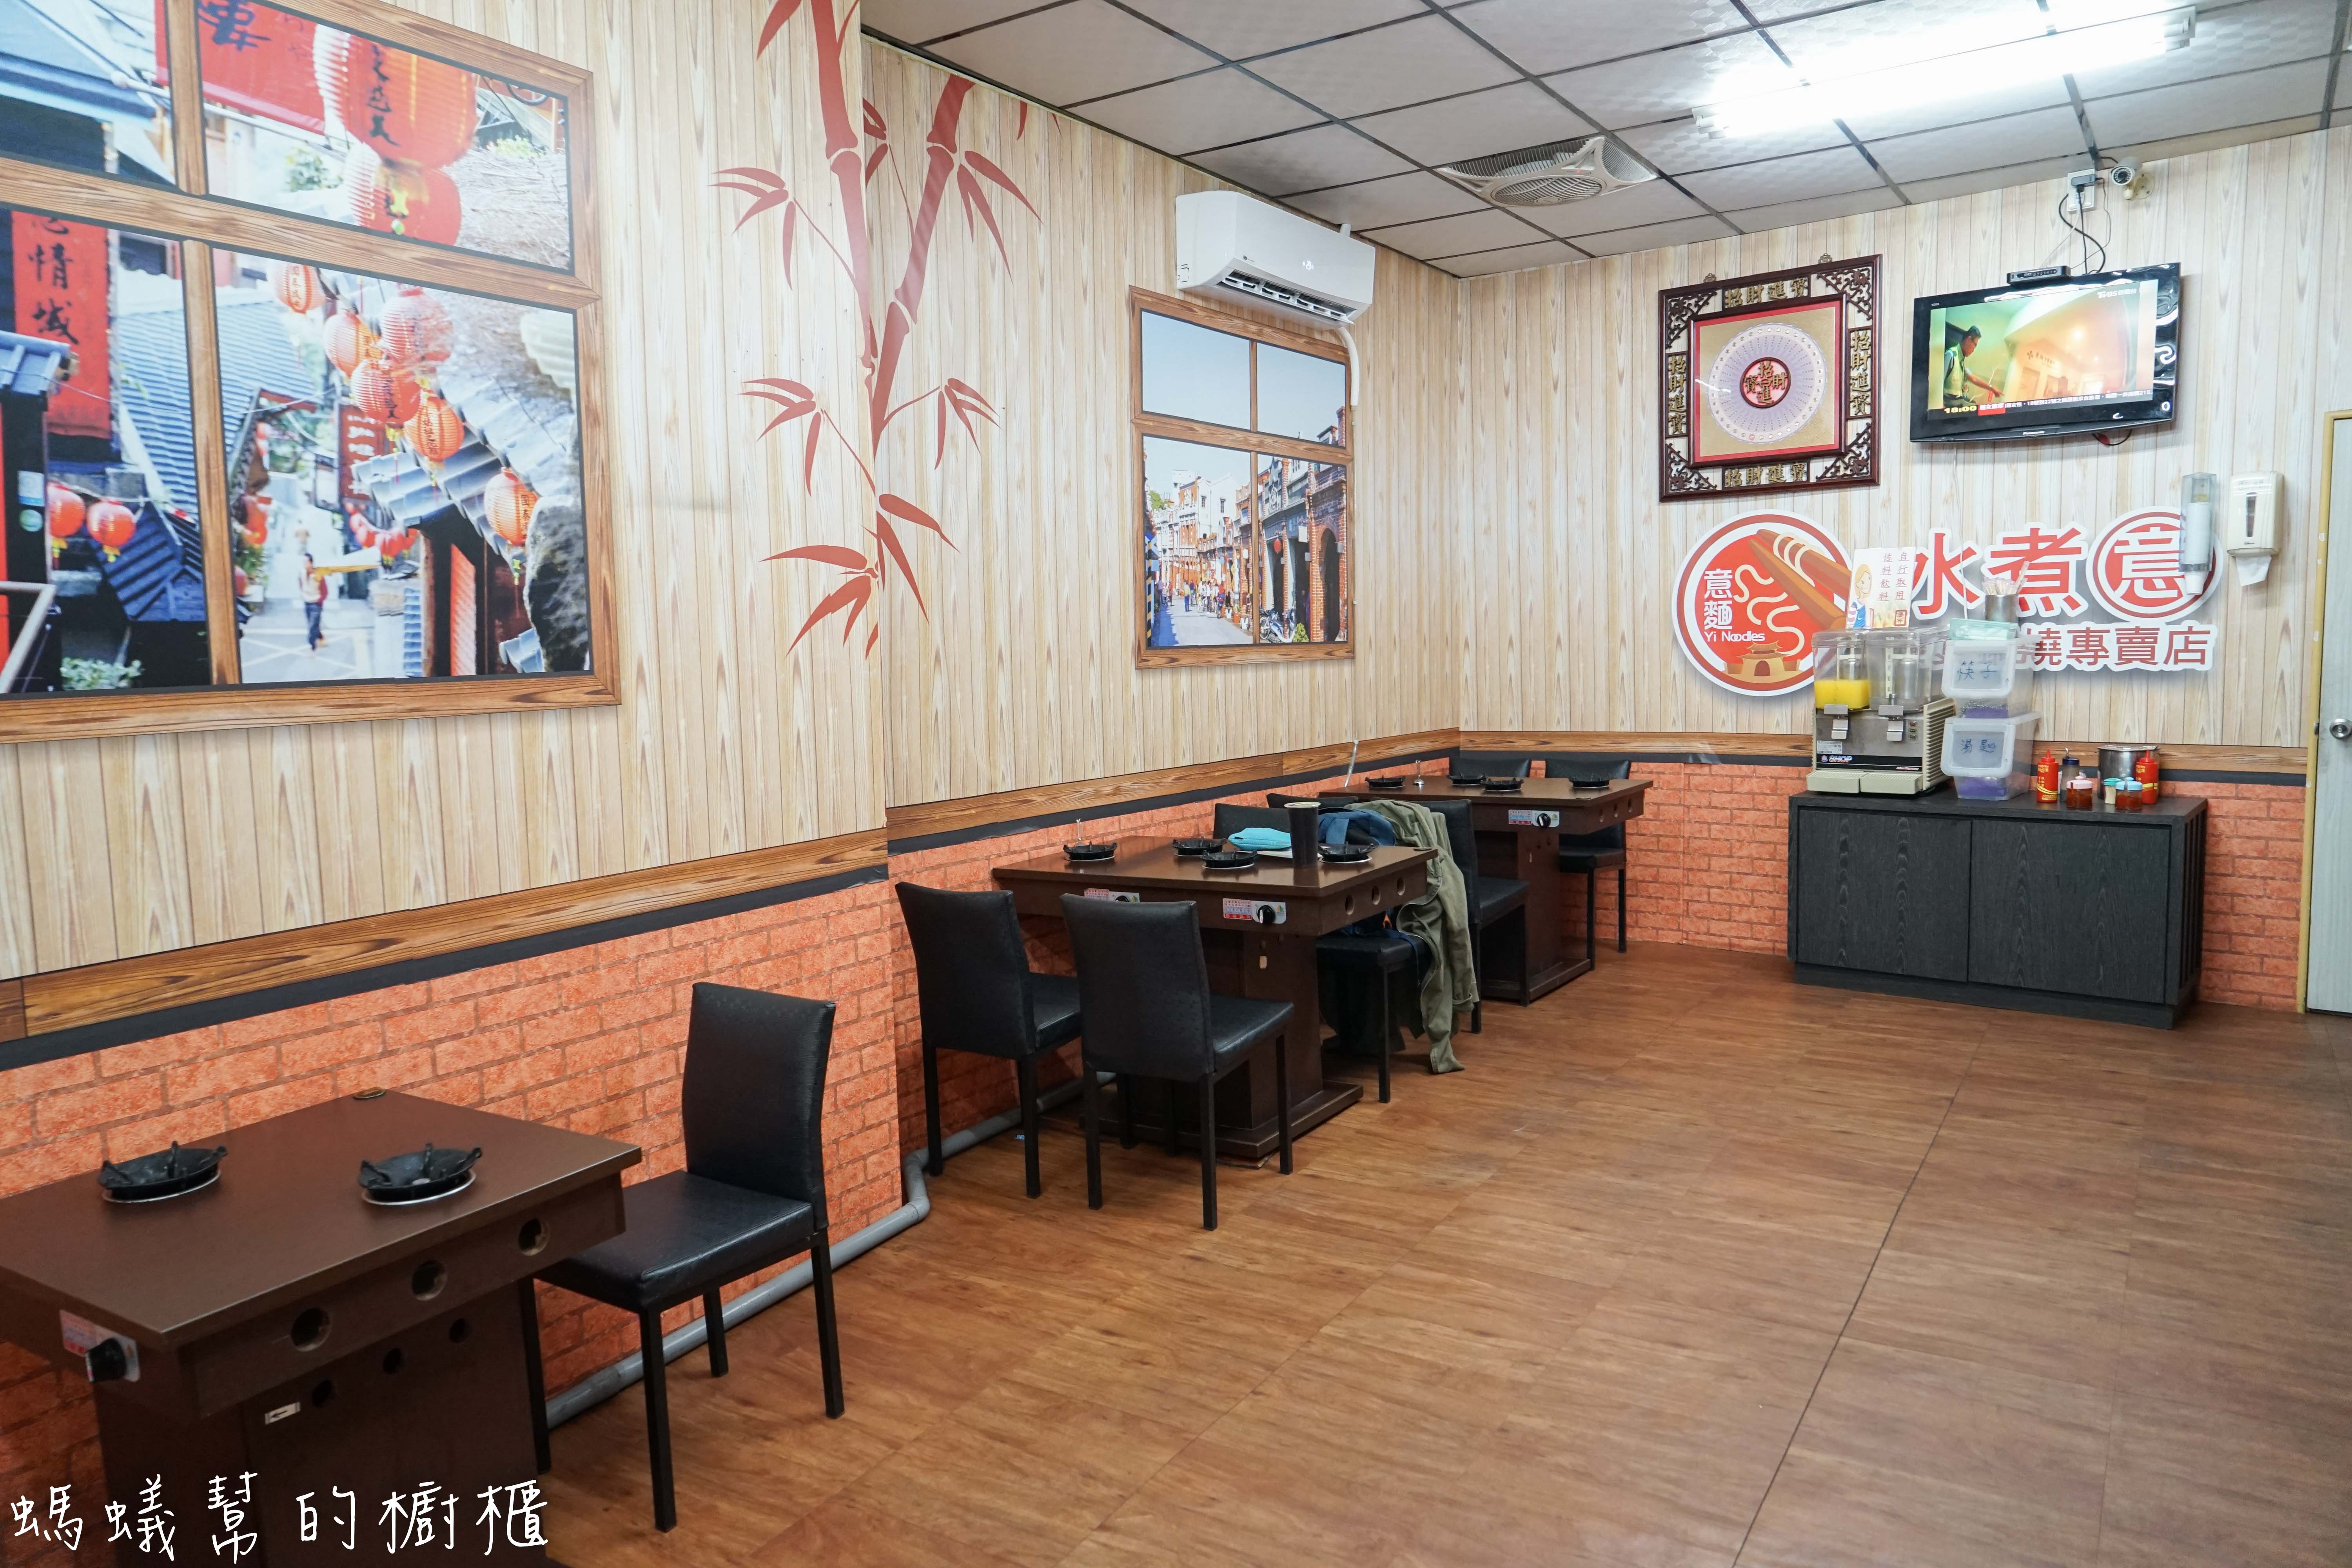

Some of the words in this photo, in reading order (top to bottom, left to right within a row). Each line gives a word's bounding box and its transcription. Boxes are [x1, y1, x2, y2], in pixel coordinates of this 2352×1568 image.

[1724, 278, 1808, 307] 招財進寶
[1850, 331, 1871, 416] 招財進寶
[1668, 357, 1686, 434] 招財進寶
[1944, 405, 1977, 414] 18:00
[1725, 463, 1807, 487] 招財進寶
[1878, 553, 1893, 601] 佐料飲料
[1896, 552, 1909, 600] 自行取用
[1704, 568, 1733, 630] 意麵
[1705, 631, 1716, 641] Yi
[1722, 630, 1765, 641] Noodles
[1957, 661, 1997, 681] 筷子
[1960, 739, 1996, 754] 湯匙
